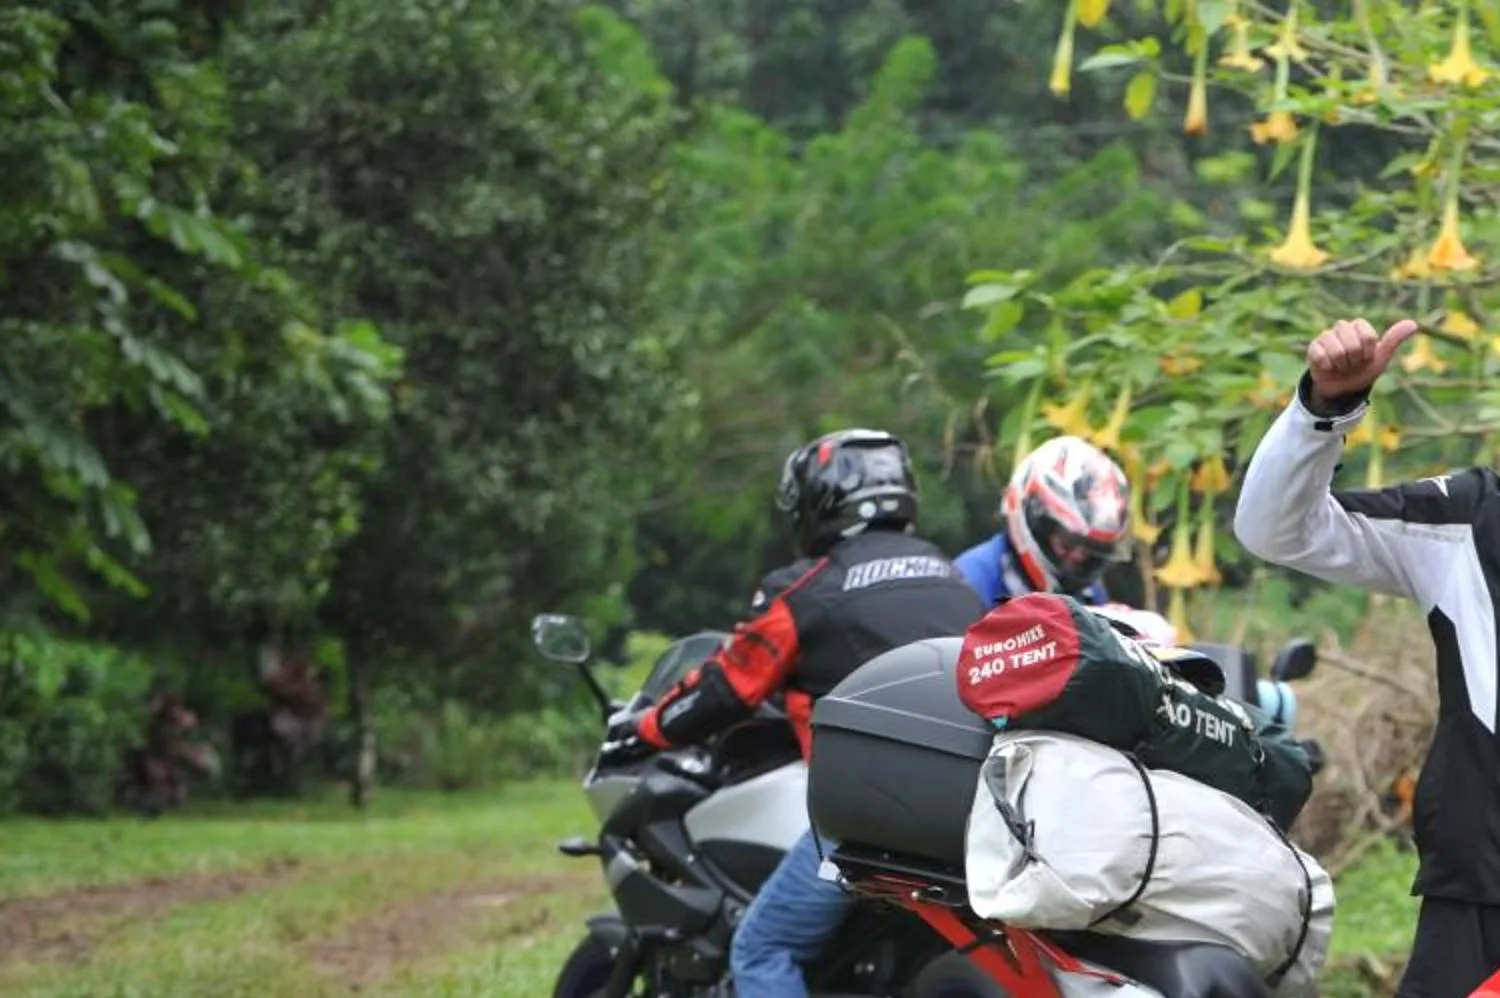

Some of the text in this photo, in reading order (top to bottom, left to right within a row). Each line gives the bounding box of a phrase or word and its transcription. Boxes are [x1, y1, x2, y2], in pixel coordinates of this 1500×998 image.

[974, 623, 1047, 660] EUROHIKE
[968, 641, 1057, 686] 240 TENT
[1195, 707, 1237, 748] TENT
